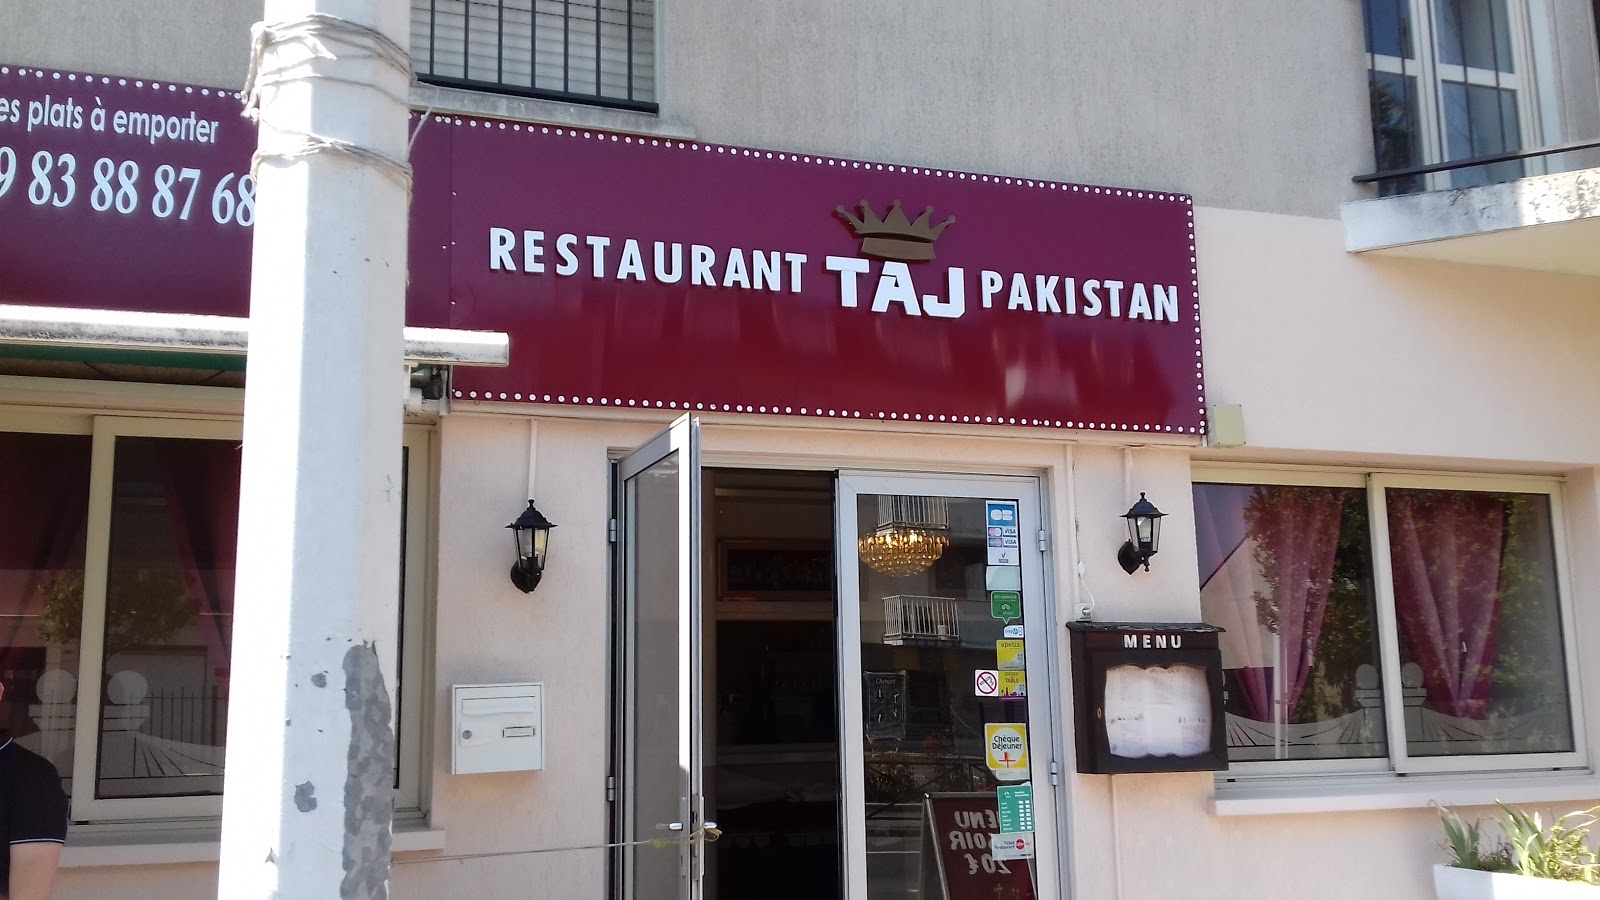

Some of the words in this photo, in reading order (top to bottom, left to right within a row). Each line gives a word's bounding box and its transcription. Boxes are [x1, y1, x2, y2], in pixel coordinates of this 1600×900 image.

[27, 94, 83, 132] plats
[90, 96, 106, 132] à
[113, 109, 220, 144] emporter
[28, 150, 76, 208] 83
[91, 157, 139, 214] 88
[152, 164, 201, 221] 87
[212, 172, 257, 227] 68
[489, 226, 808, 294] RESTAURANT
[825, 255, 966, 319] TAJ
[981, 270, 1180, 323] PAKISTAN
[1123, 634, 1182, 649] MENU
[991, 741, 1023, 752] Déjeuner
[993, 734, 1020, 746] Chèque
